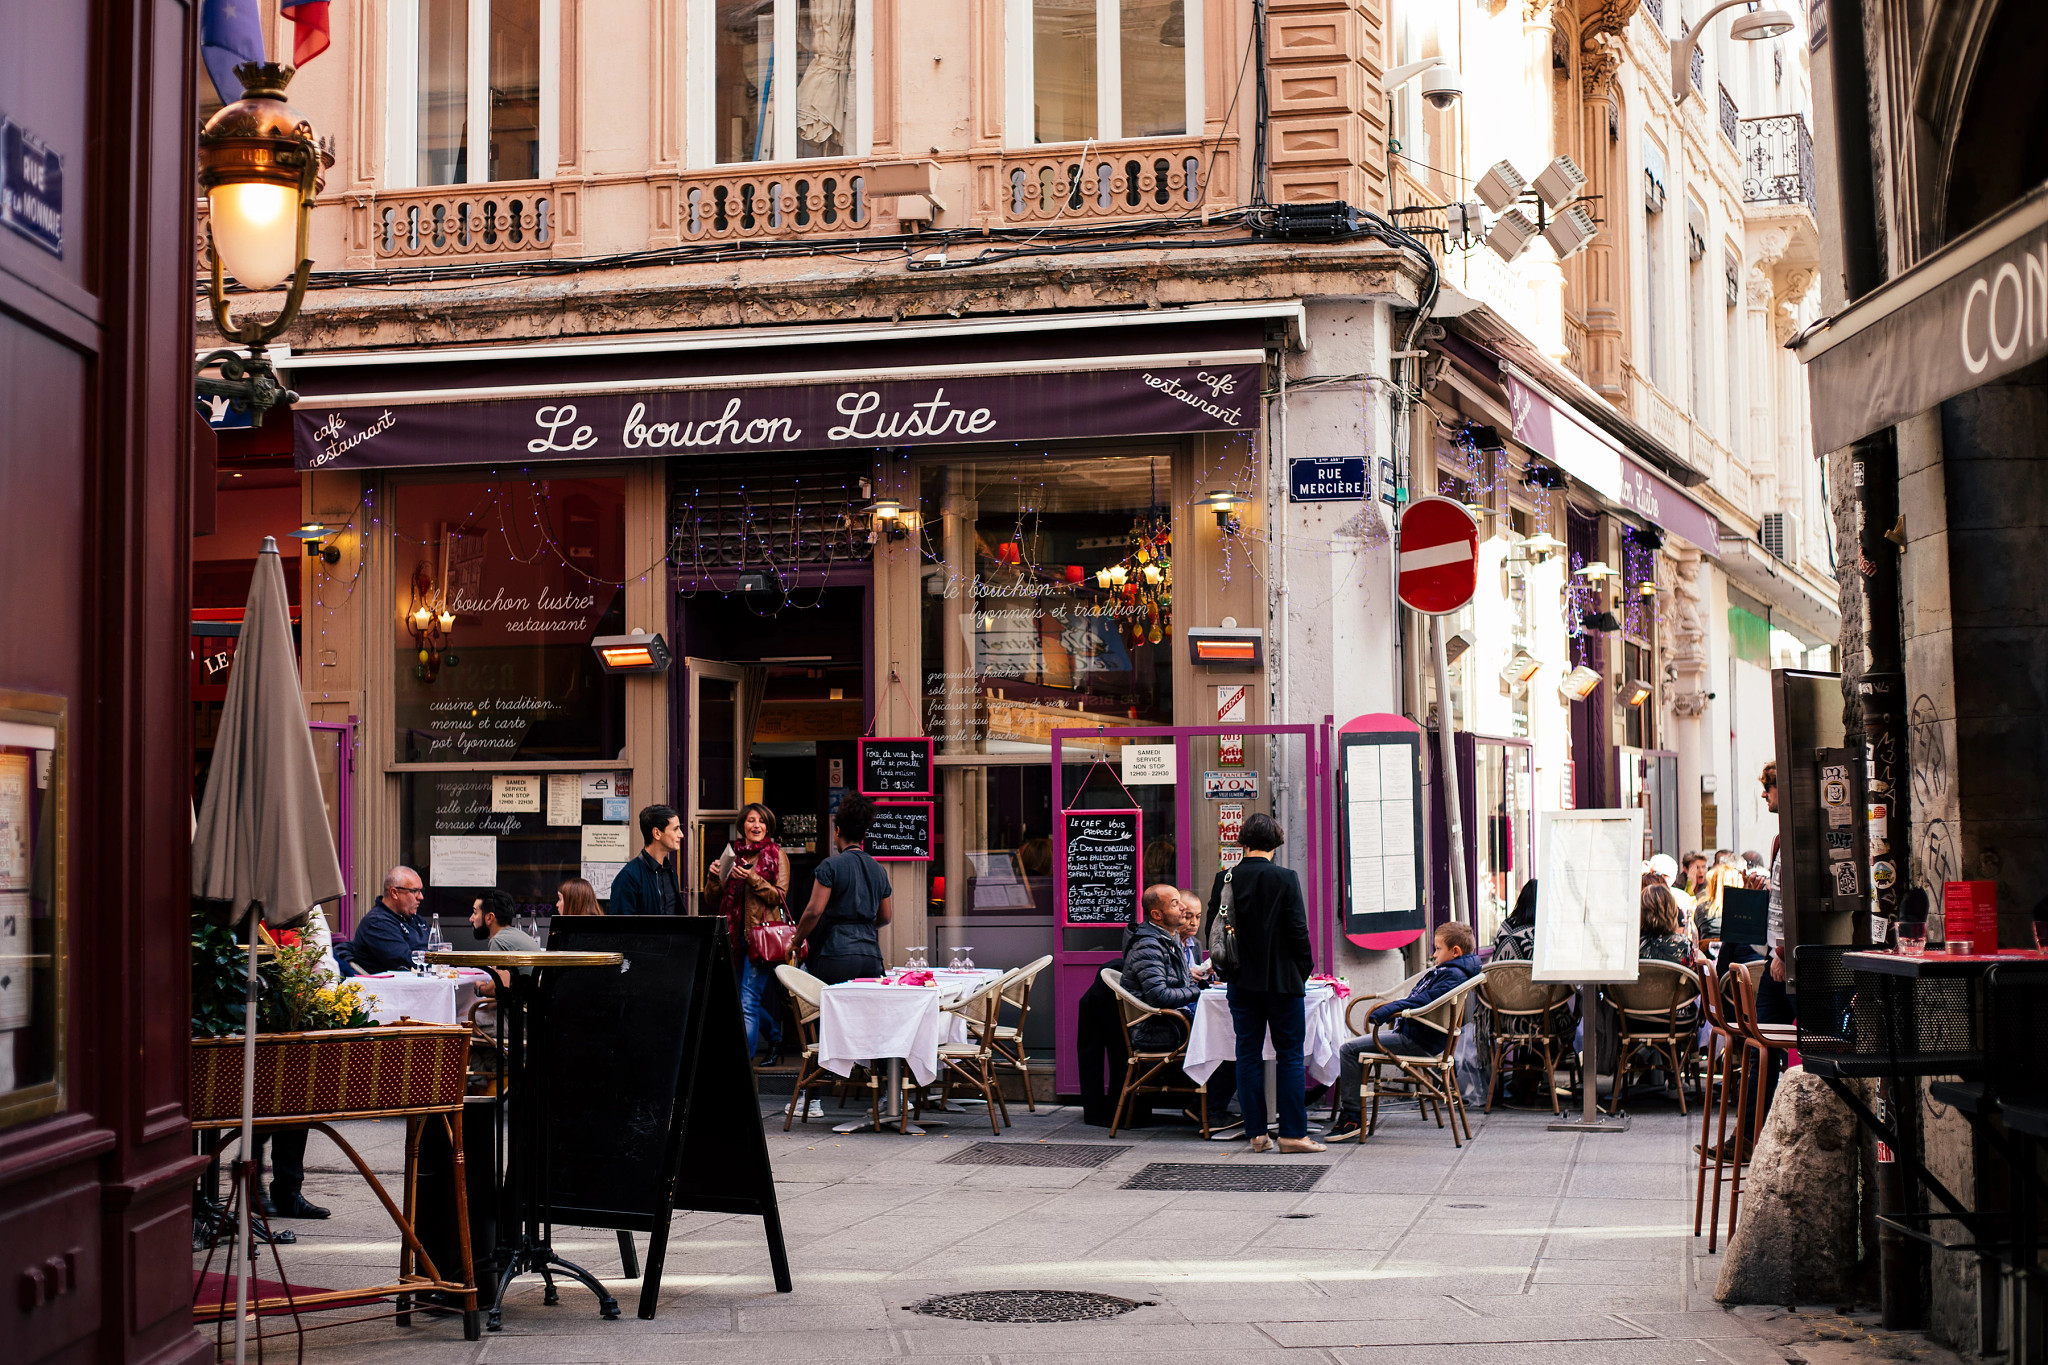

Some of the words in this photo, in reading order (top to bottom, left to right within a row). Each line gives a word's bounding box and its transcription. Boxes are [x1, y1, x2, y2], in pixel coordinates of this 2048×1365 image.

[23, 155, 45, 192] RUE
[13, 194, 22, 213] LA
[24, 192, 61, 238] MONNAIE
[1197, 371, 1238, 398] café
[1142, 373, 1242, 426] restaurant
[313, 412, 346, 442] café
[527, 404, 599, 453] Le
[622, 397, 801, 449] bouchon
[827, 387, 997, 440] Lustre
[309, 408, 397, 468] restaurant
[1318, 468, 1342, 479] RUE
[1300, 480, 1361, 494] MERCIÈRE
[452, 587, 530, 612] bouchon
[537, 586, 590, 611] lustre
[969, 601, 1046, 629] lyonnais
[1052, 603, 1068, 618] et
[1074, 600, 1149, 618] tradition
[506, 616, 587, 632] restaurant
[204, 651, 229, 675] LE
[927, 667, 980, 684] grenouilles
[430, 697, 474, 711] cuisine
[478, 699, 490, 711] et
[972, 699, 982, 710] de
[1031, 698, 1041, 708] de
[1045, 699, 1070, 708] veau
[1220, 690, 1243, 717] LICENCE
[430, 718, 474, 731] menus
[478, 718, 490, 730] et
[494, 718, 526, 730] carte
[928, 714, 947, 731] foie
[949, 716, 960, 726] de
[964, 718, 989, 726] veau
[972, 730, 982, 741] de
[429, 735, 452, 754] pot
[458, 732, 517, 755] lyonnais
[1218, 748, 1244, 758] petit
[1208, 780, 1254, 790] LYON
[436, 800, 461, 814] salle
[1222, 811, 1242, 820] 2016
[435, 818, 475, 830] terrasse
[1070, 818, 1079, 826] LE
[1080, 820, 1102, 828] CHEF
[1084, 828, 1112, 836] PROPOSE
[1223, 833, 1239, 841] fut
[1223, 852, 1242, 861] 2017
[1114, 913, 1131, 921] 22€
